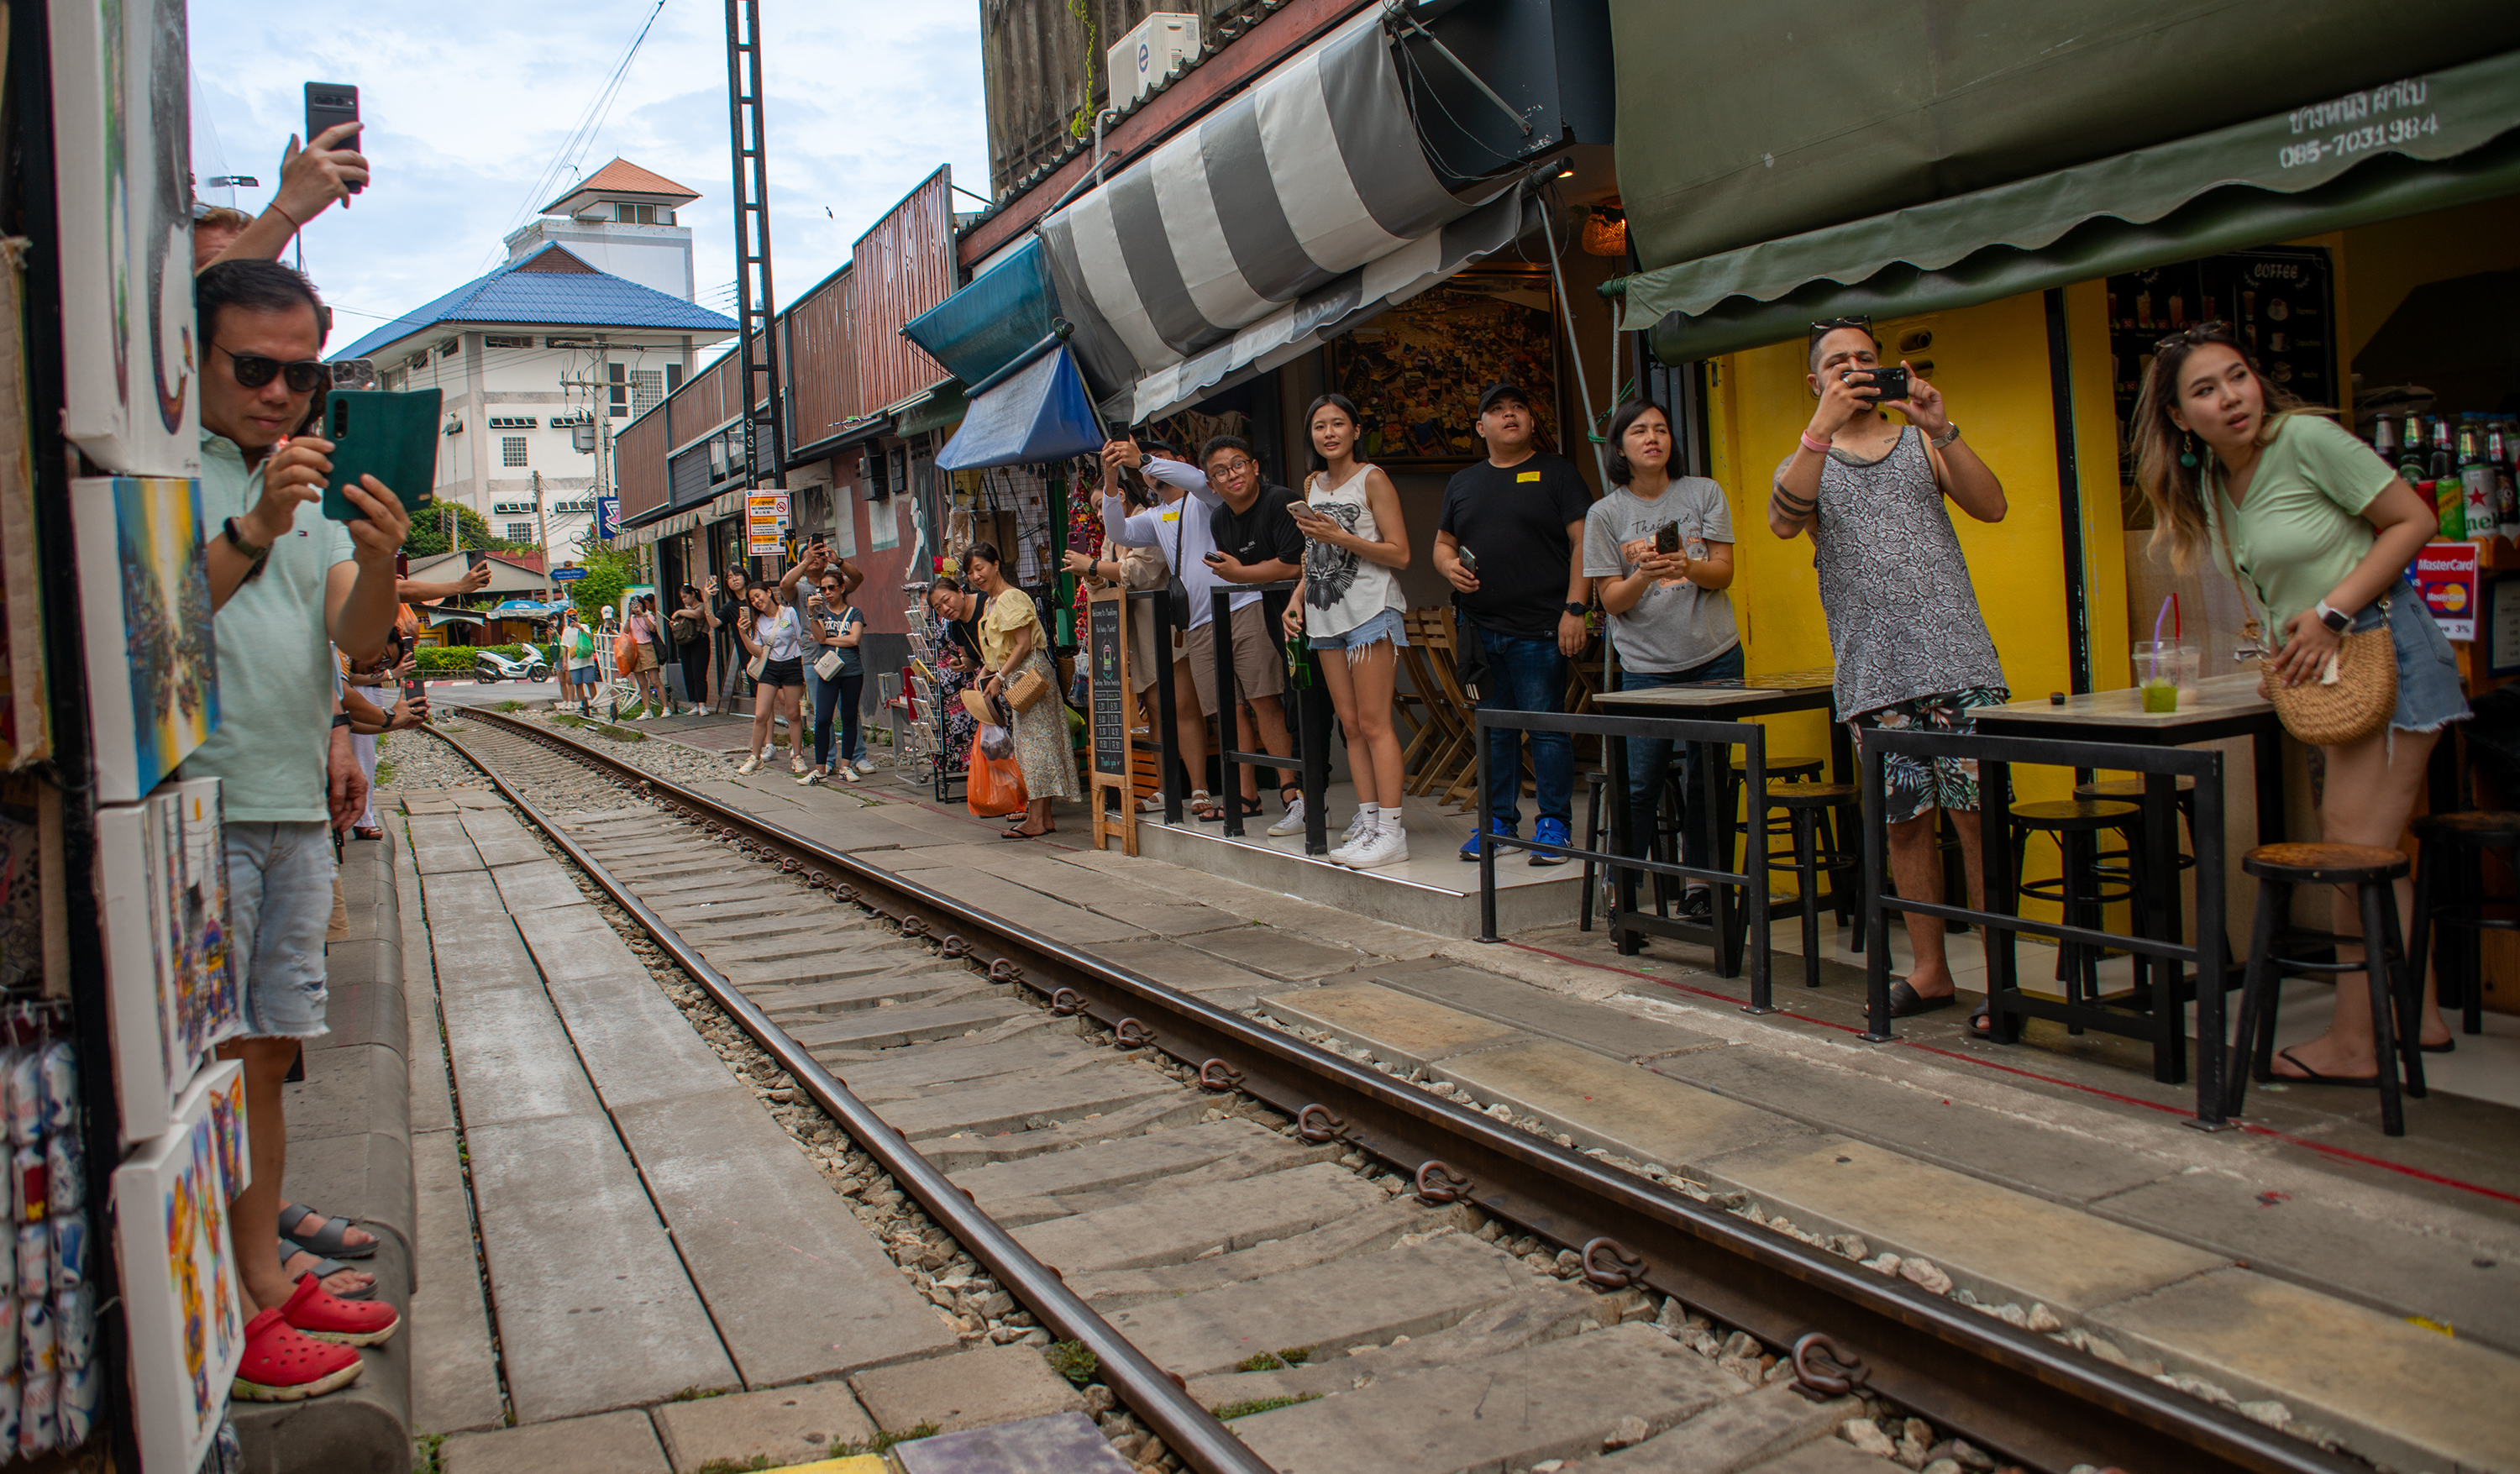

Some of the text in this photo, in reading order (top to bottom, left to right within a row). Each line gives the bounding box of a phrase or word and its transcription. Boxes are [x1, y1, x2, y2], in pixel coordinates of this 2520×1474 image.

[2279, 112, 2439, 169] 085-7031984
[2254, 263, 2299, 280] COFFEE
[2418, 559, 2474, 572] MasterCard
[2426, 593, 2465, 602] MasterCard
[2455, 625, 2470, 633] 3%
